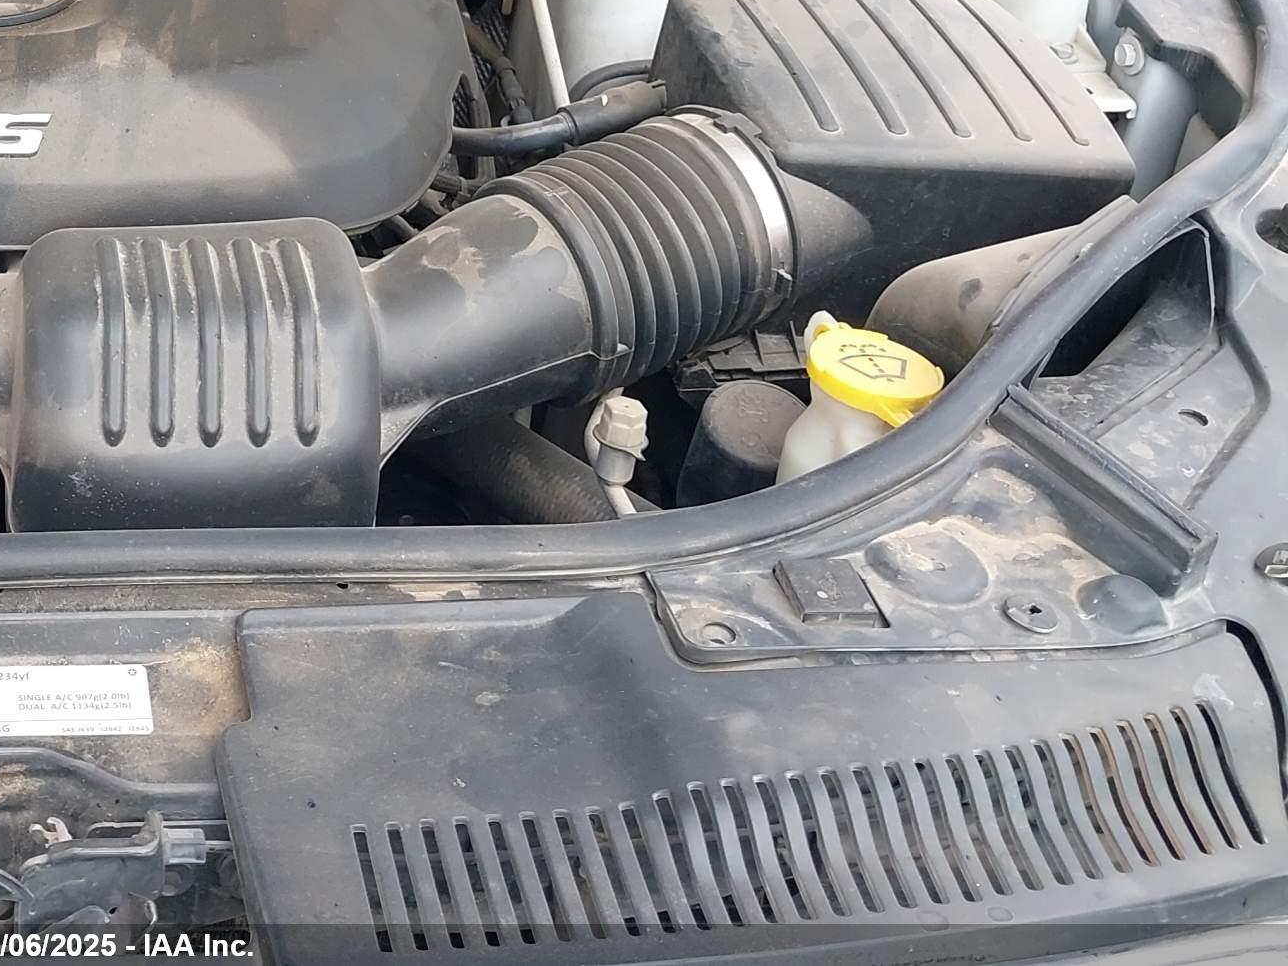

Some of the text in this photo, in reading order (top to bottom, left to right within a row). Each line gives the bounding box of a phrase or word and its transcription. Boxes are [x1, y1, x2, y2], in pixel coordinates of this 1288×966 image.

[16, 693, 53, 702] SINGLE
[54, 693, 73, 702] A/C
[18, 702, 45, 711] DUAL
[50, 702, 69, 711] A/C
